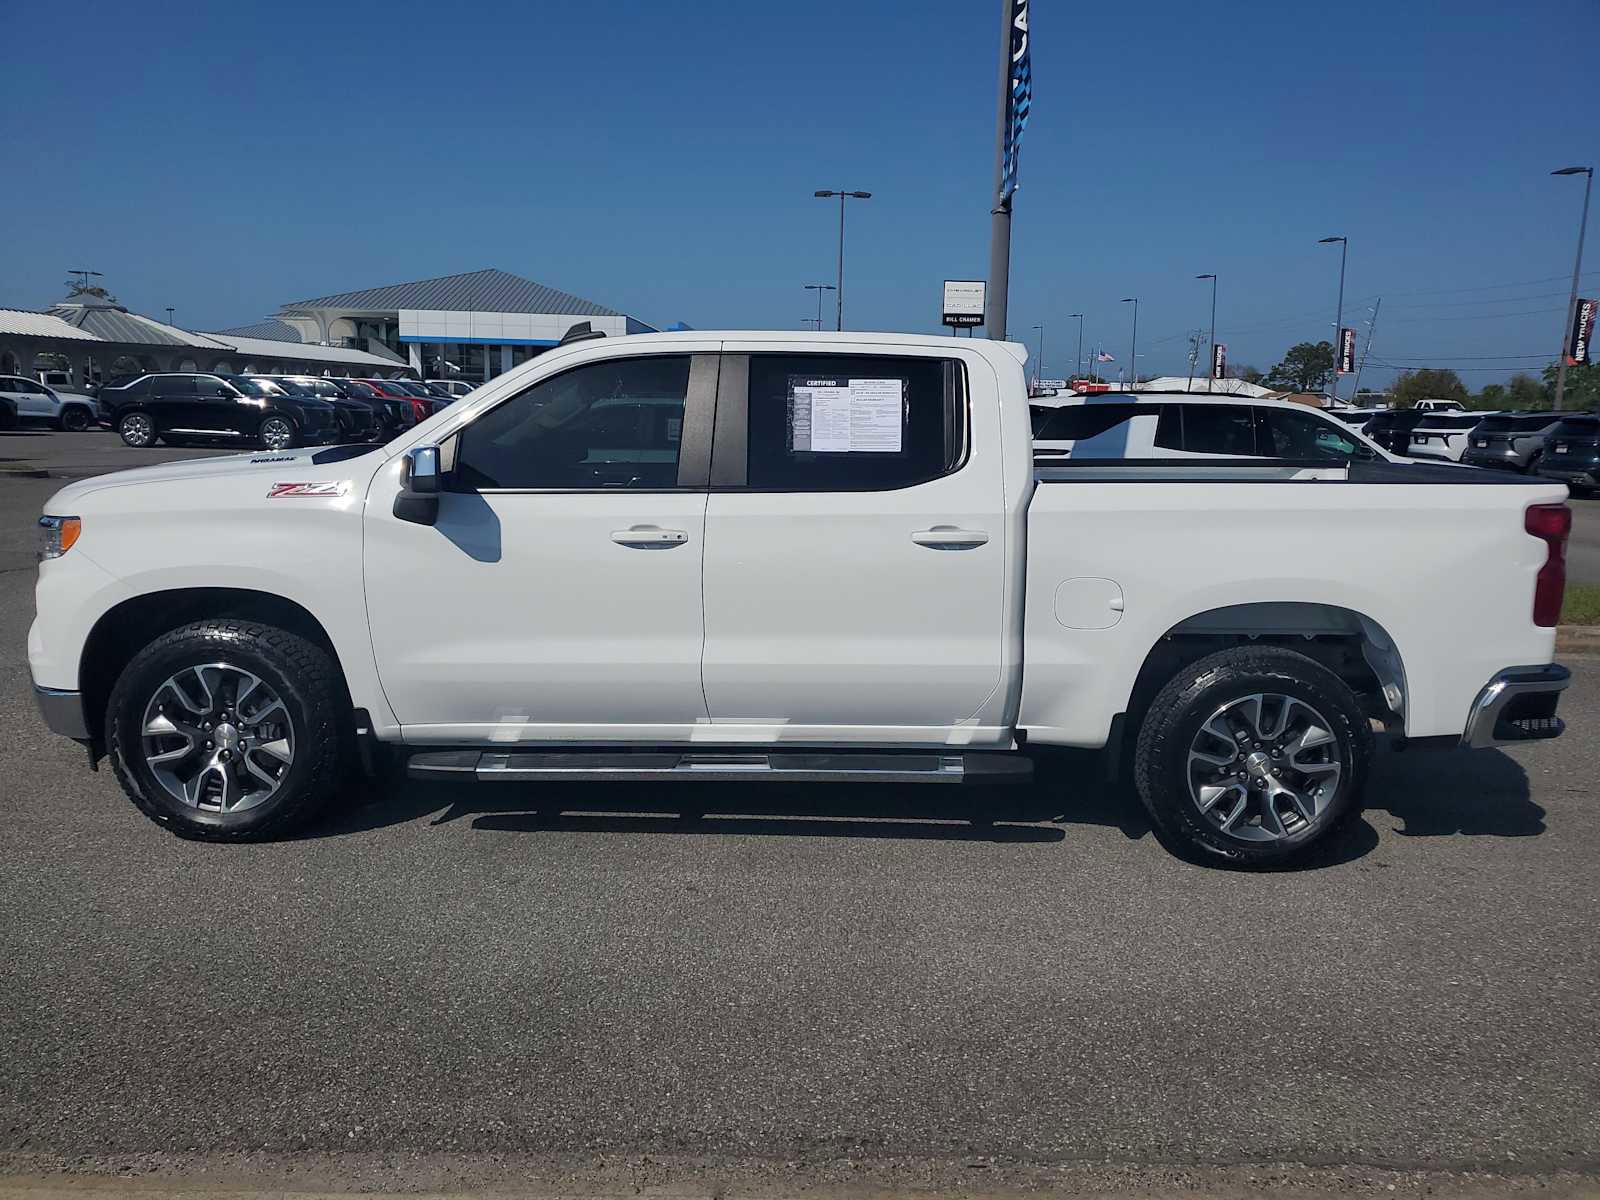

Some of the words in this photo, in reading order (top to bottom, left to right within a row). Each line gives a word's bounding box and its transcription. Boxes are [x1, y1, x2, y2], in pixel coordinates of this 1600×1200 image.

[1012, 0, 1028, 62] CA
[1579, 303, 1591, 339] TRUCKS
[1344, 331, 1352, 357] TRUCKS
[1575, 340, 1585, 361] NEW
